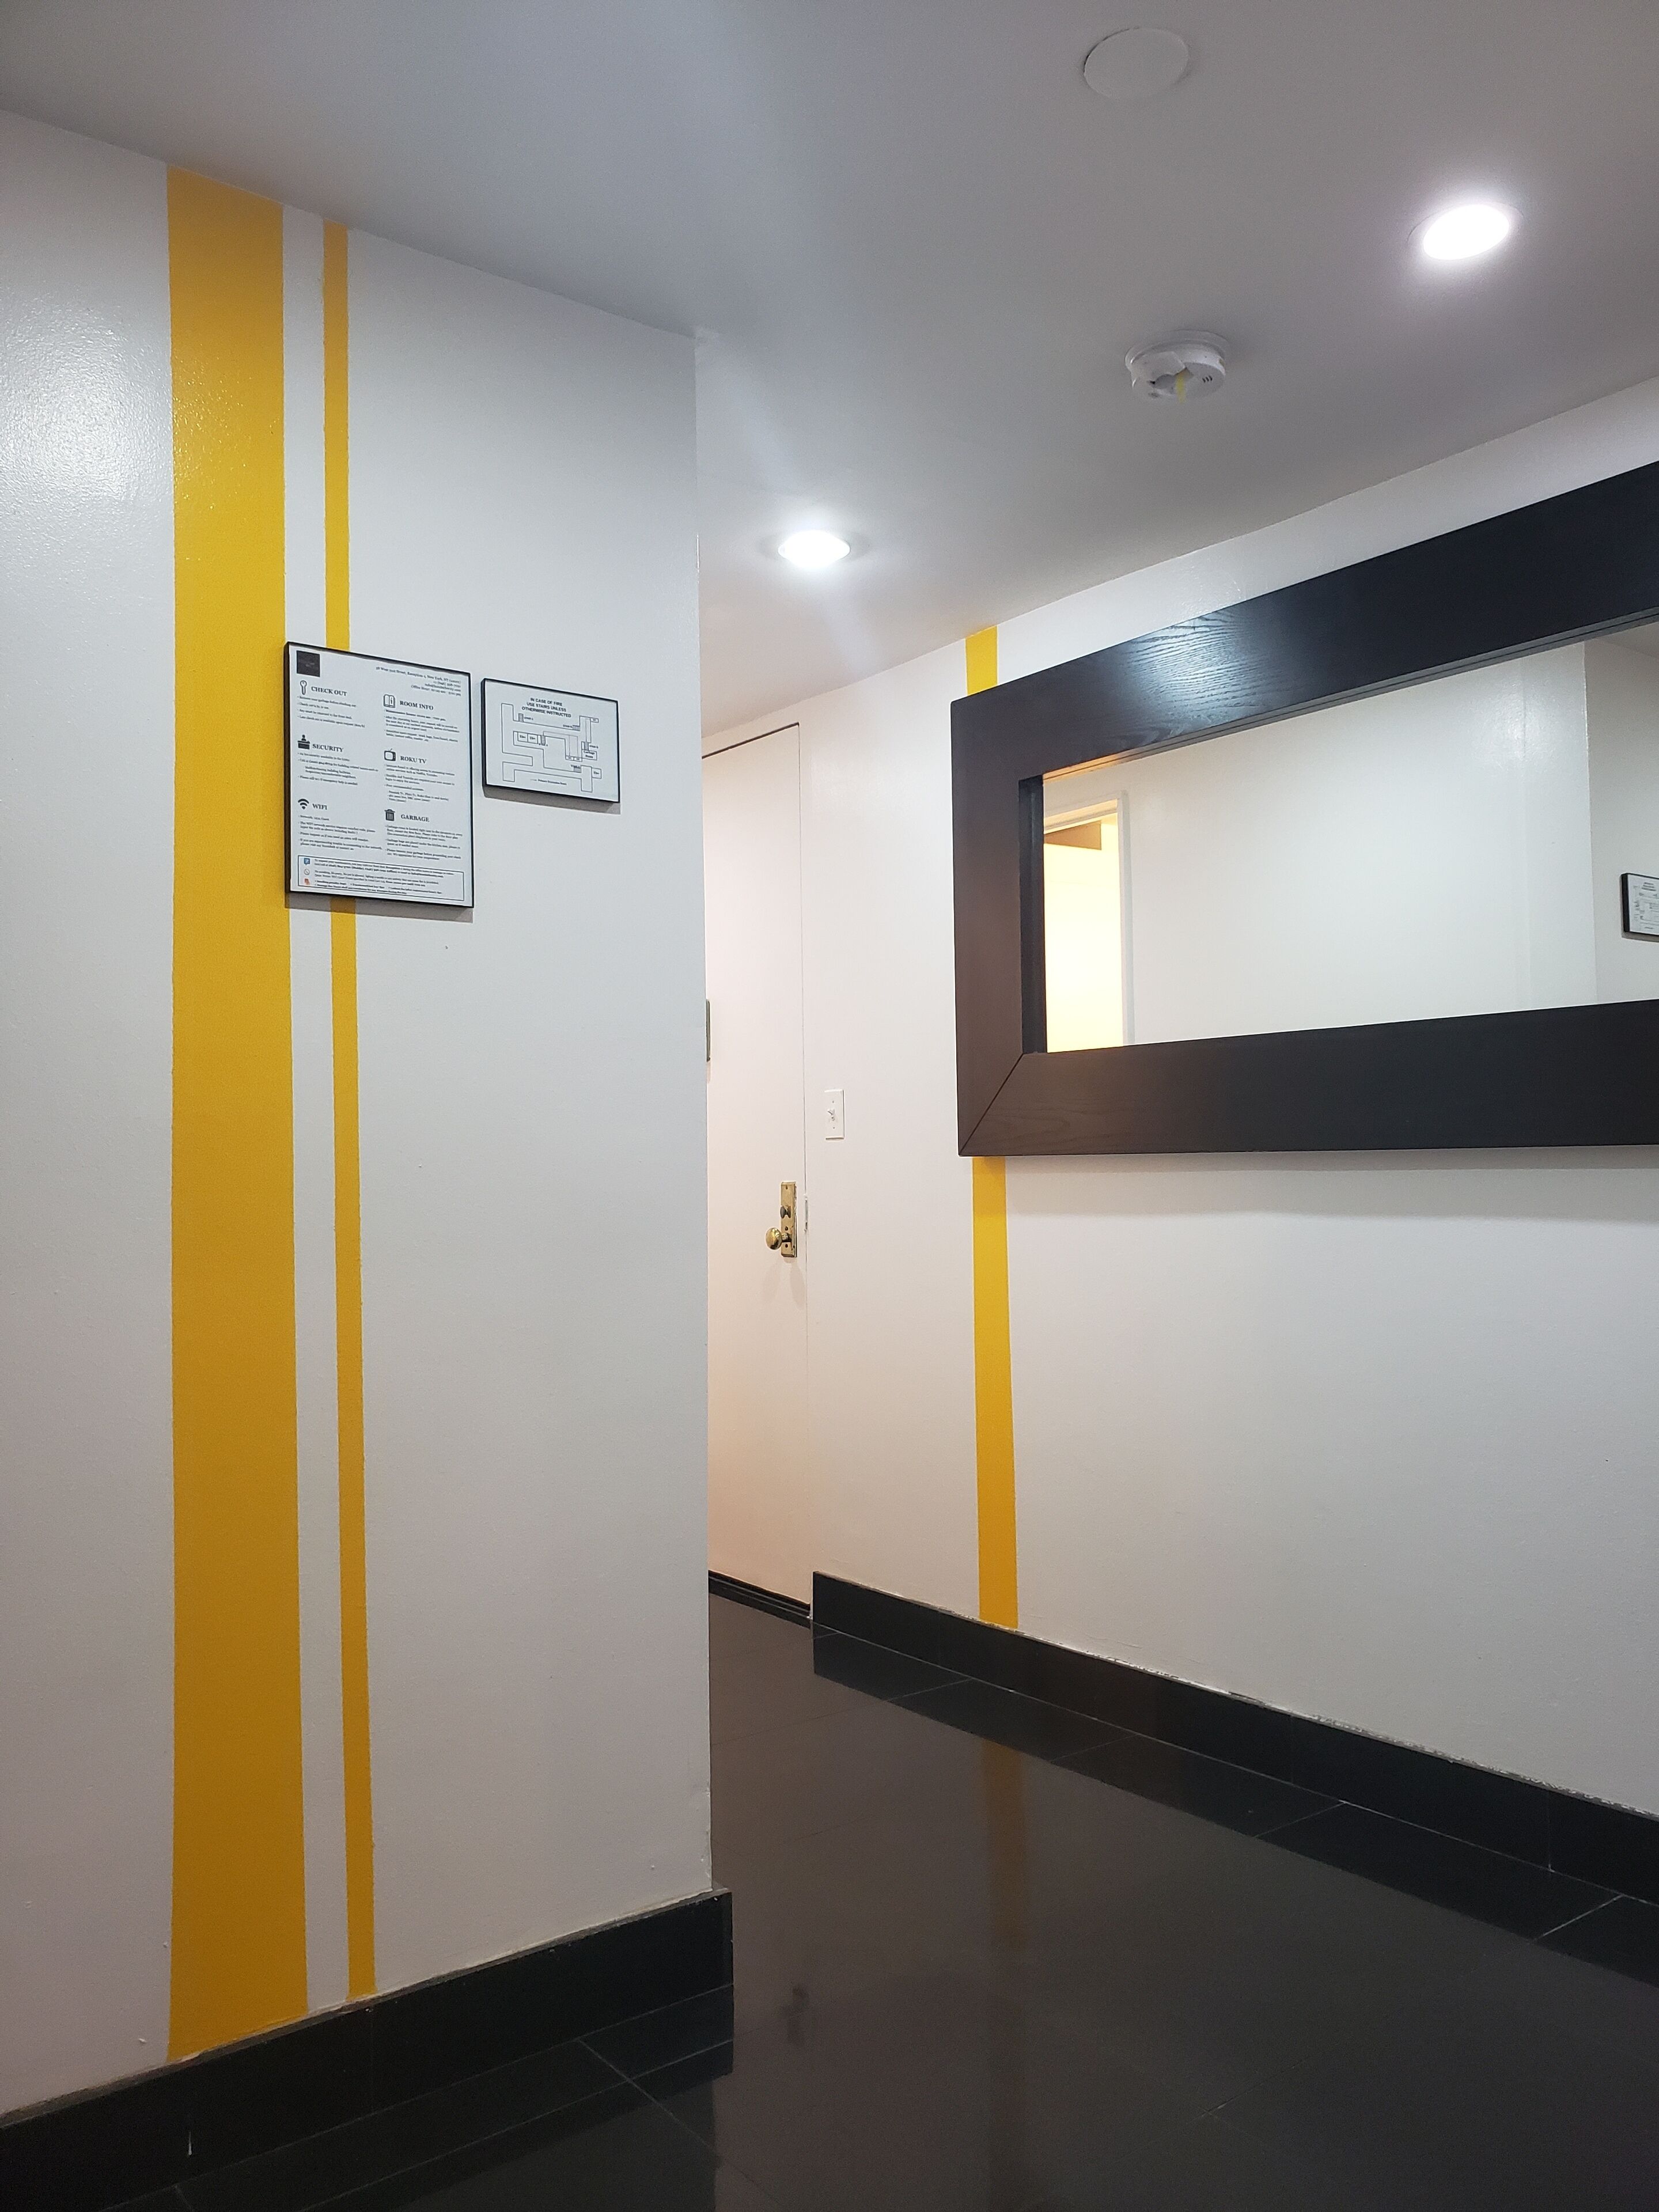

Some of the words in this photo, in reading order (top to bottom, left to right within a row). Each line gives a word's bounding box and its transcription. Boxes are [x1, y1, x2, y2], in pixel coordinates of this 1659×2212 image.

[311, 686, 333, 694] CHECK
[400, 700, 418, 708] ROOM
[312, 744, 344, 752] SECURITY
[400, 814, 430, 823] GARBAGE
